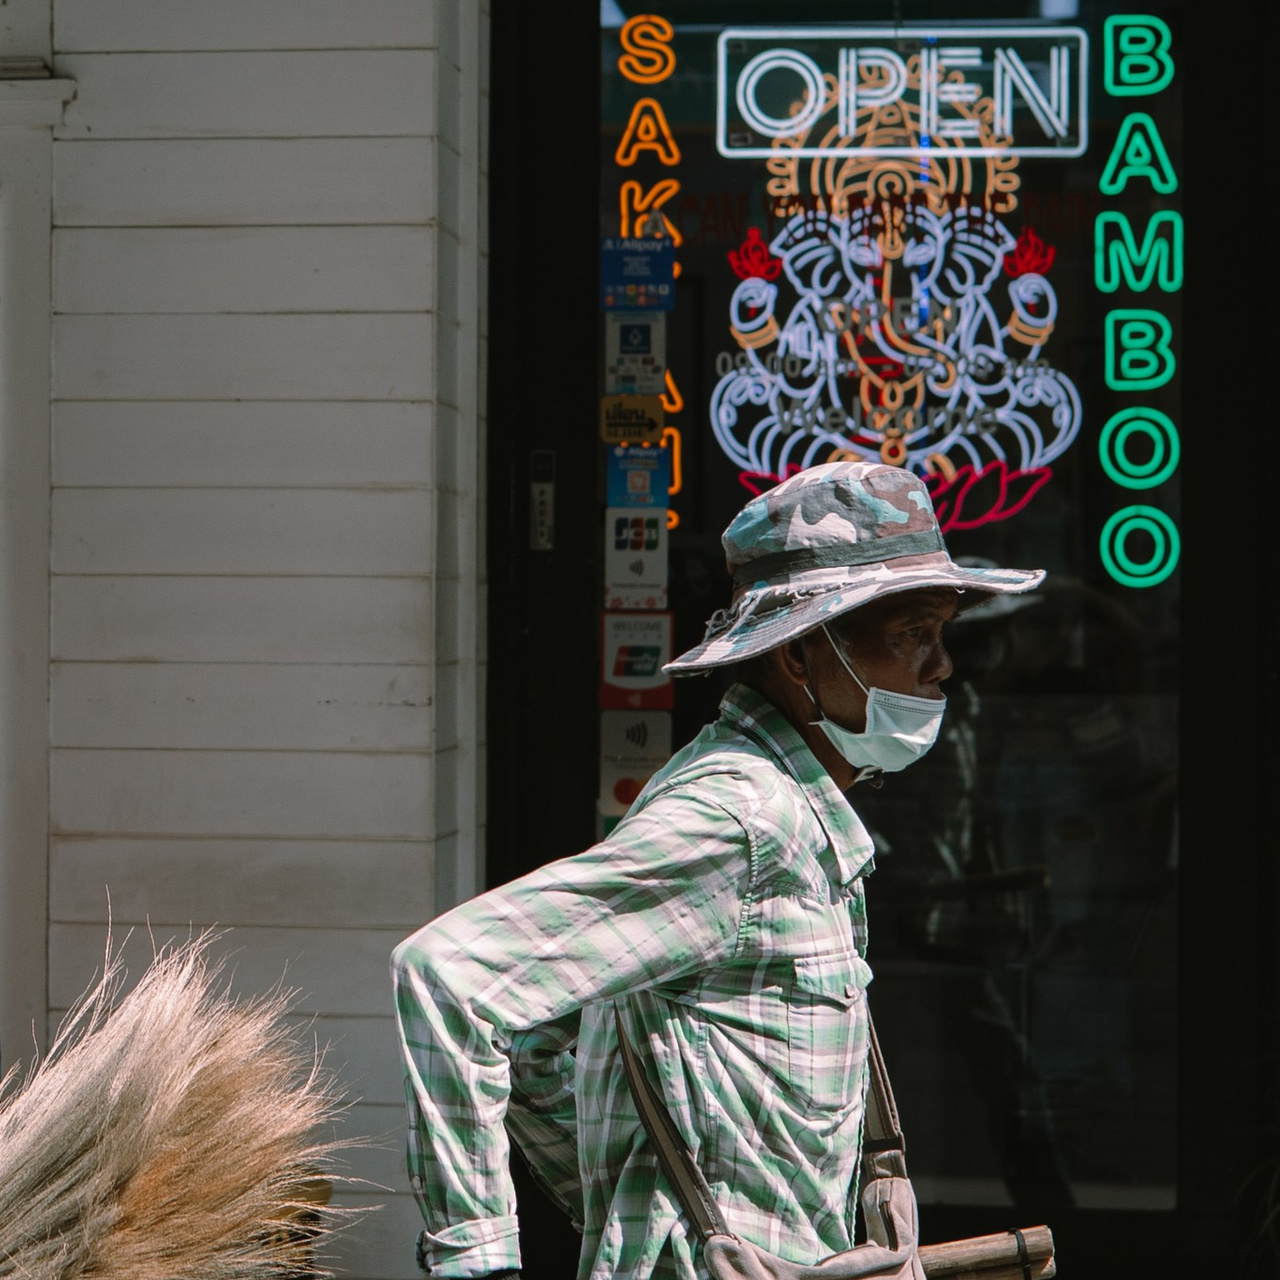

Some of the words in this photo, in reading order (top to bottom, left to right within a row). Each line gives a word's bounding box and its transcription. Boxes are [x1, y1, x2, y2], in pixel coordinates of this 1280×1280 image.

[736, 46, 1070, 138] OPEN
[818, 298, 958, 335] OPEN
[1094, 14, 1184, 588] BAMBOO
[715, 352, 802, 378] 0900
[778, 396, 998, 435] Welcome
